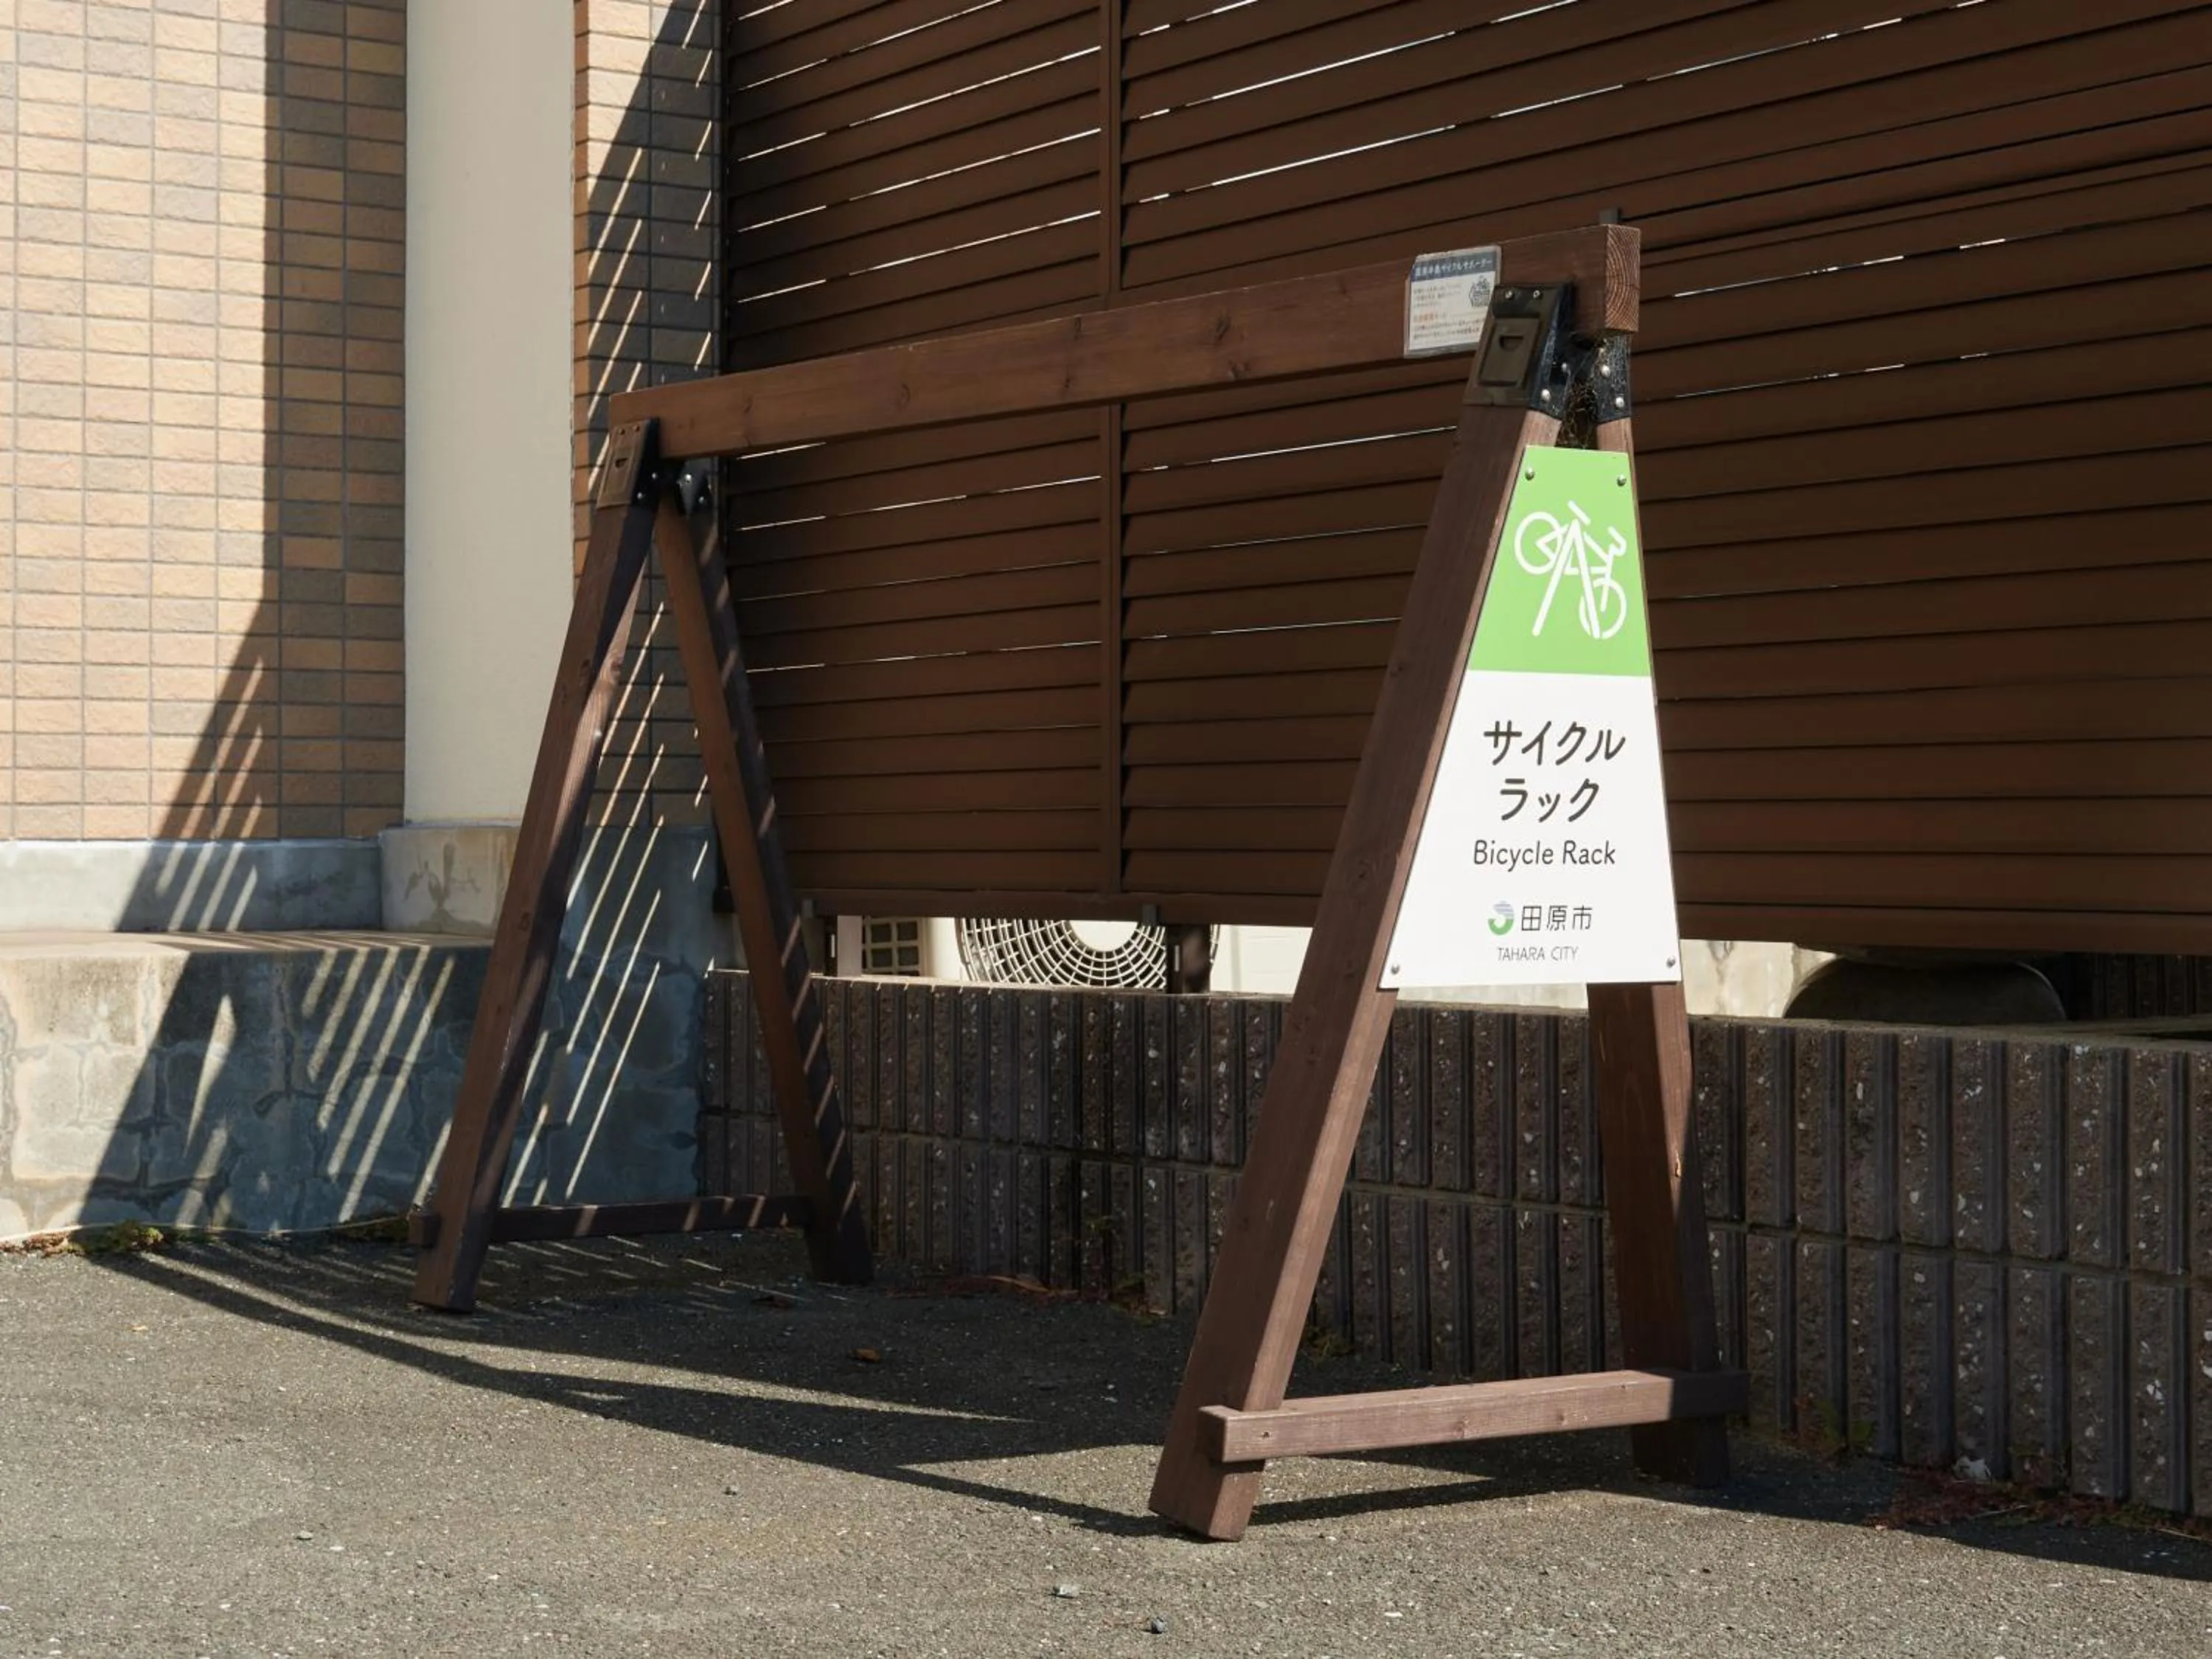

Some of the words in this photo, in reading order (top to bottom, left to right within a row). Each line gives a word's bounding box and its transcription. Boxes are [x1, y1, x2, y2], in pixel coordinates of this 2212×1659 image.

[1484, 720, 1626, 766] サイクル
[1500, 778, 1599, 823] ラック
[1473, 839, 1554, 872] Bicycle
[1562, 840, 1615, 866] Rack
[1521, 905, 1593, 931] 田原市
[1498, 946, 1546, 962] TAHARA
[1550, 945, 1579, 961] CITY
